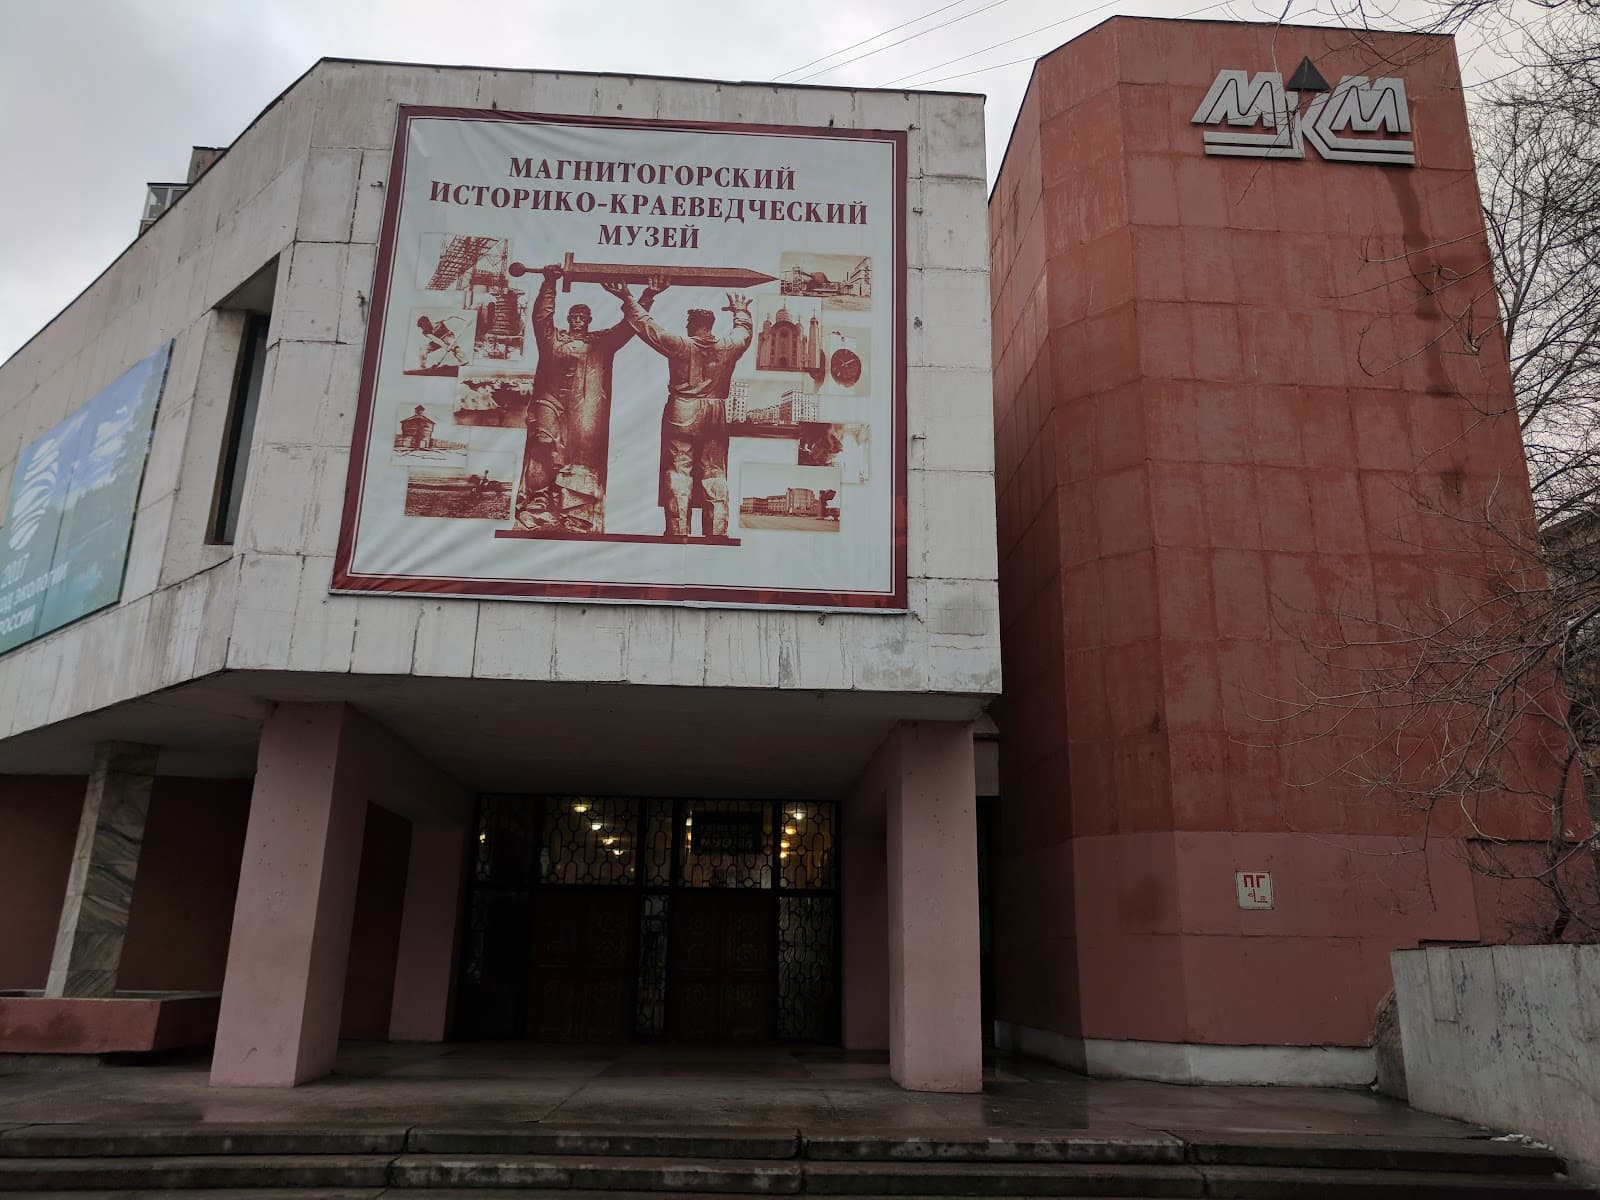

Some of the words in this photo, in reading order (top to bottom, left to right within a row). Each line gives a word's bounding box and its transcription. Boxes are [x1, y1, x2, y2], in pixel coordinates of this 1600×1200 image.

[508, 156, 797, 191] МАГНИТОГОРСКИЙ
[429, 180, 869, 226] ИСТОРИКО-КРАЕВЕДЧЕСКИЙ
[598, 223, 701, 250] МУЗЕЙ
[1243, 874, 1266, 888] ПГ
